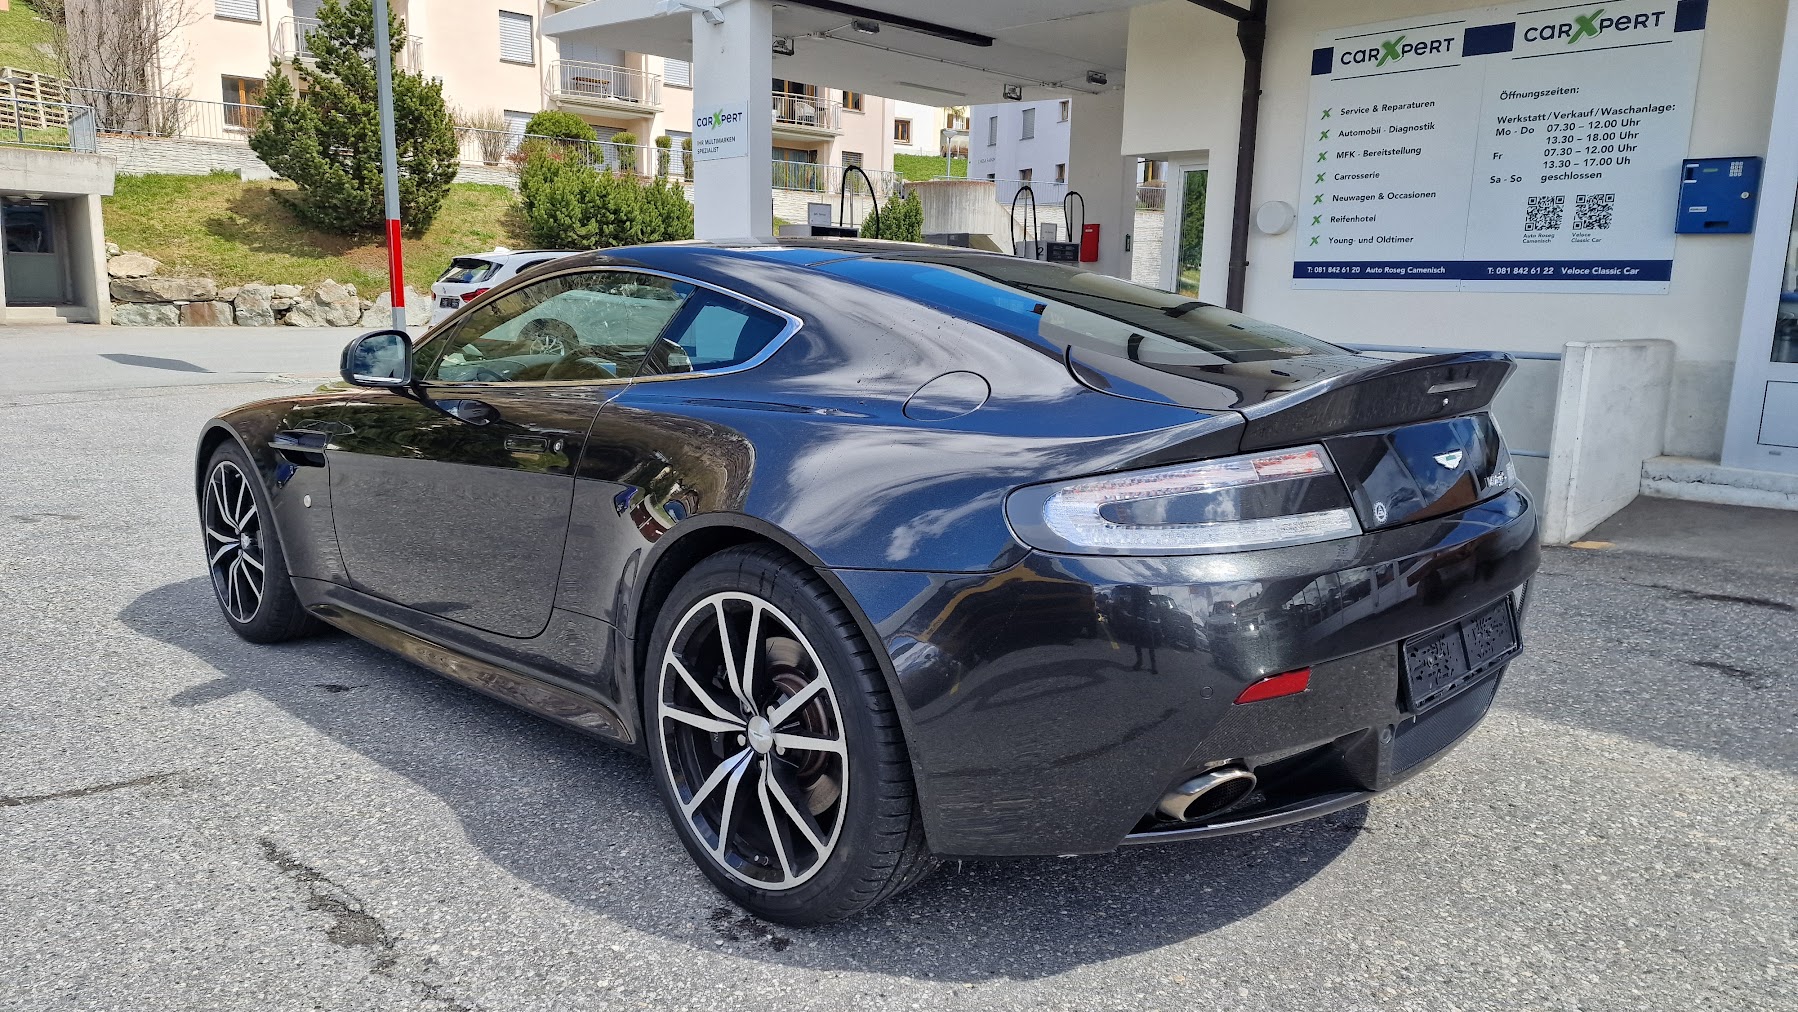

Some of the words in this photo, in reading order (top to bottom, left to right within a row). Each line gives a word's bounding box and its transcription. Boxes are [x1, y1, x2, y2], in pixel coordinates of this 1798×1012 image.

[1500, 86, 1580, 100] Öffnungszeiten:
[1340, 106, 1370, 116] Service
[1372, 105, 1378, 113] &
[1381, 100, 1435, 113] Reparaturen
[1338, 127, 1382, 138] Automobil
[1388, 121, 1435, 135] Diagnostik
[1495, 128, 1511, 136] Mo
[1520, 126, 1535, 134] Do
[1546, 122, 1576, 133] 07.30
[1588, 119, 1618, 129] 12.00
[1621, 118, 1641, 127] Uhr
[705, 136, 736, 145] MULTIMARKEN
[1545, 135, 1574, 145] 13.30
[1586, 132, 1616, 142] 18.00
[1619, 131, 1640, 140] Uhr
[697, 146, 719, 155] SPEZIALIST
[1336, 150, 1355, 159] MFK
[1362, 147, 1422, 158] Bereitstellung
[1492, 152, 1503, 160] Fr
[1543, 147, 1573, 157] 07.30
[1585, 144, 1614, 155] 12.00
[1617, 144, 1638, 153] Uhr
[1543, 159, 1571, 169] 13.30
[1583, 157, 1613, 167] 17.00
[1616, 156, 1631, 165] Uh
[1334, 171, 1380, 181] Carrosserie
[1490, 175, 1501, 184] Sa
[1509, 175, 1522, 183] So
[1540, 172, 1602, 183] geschlossen
[1332, 194, 1375, 203] Neuwagen
[1387, 191, 1436, 200] Occasionen
[1330, 214, 1376, 223] Reifenhotel
[1358, 236, 1374, 244] und
[1376, 235, 1414, 244] Oldtimer
[1407, 266, 1446, 274] Camenisch
[1496, 267, 1511, 275] 081
[1513, 267, 1528, 275] 842
[1530, 267, 1541, 275] 61
[1542, 267, 1554, 275] 22
[1561, 267, 1590, 275] Veloce
[1592, 267, 1622, 275] Classic
[1623, 267, 1640, 275] Car
